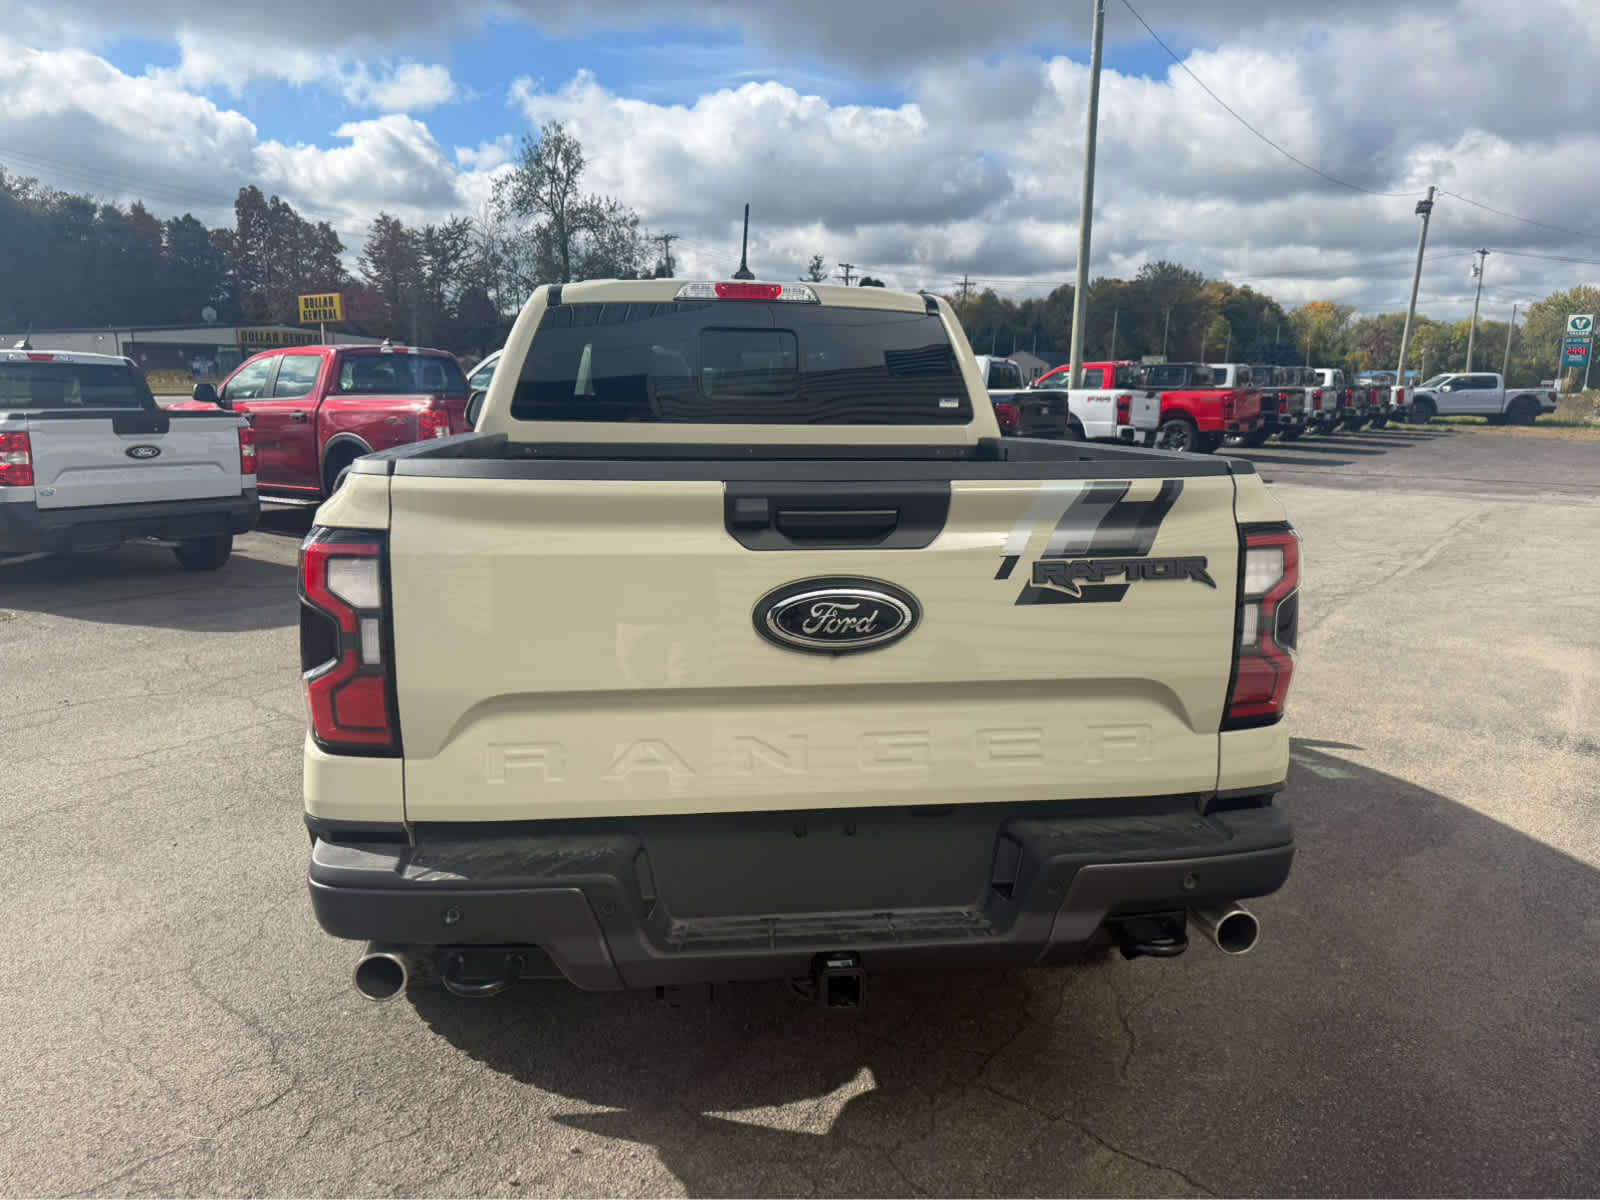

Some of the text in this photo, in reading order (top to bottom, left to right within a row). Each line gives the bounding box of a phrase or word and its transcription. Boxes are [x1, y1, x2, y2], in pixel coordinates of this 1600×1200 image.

[304, 296, 334, 308] DOLLAR
[303, 309, 337, 321] GENERAL
[281, 332, 324, 345] GENERA
[1032, 556, 1217, 594] RAPTOR
[802, 602, 879, 634] Ford
[482, 721, 1153, 783] RANGER
